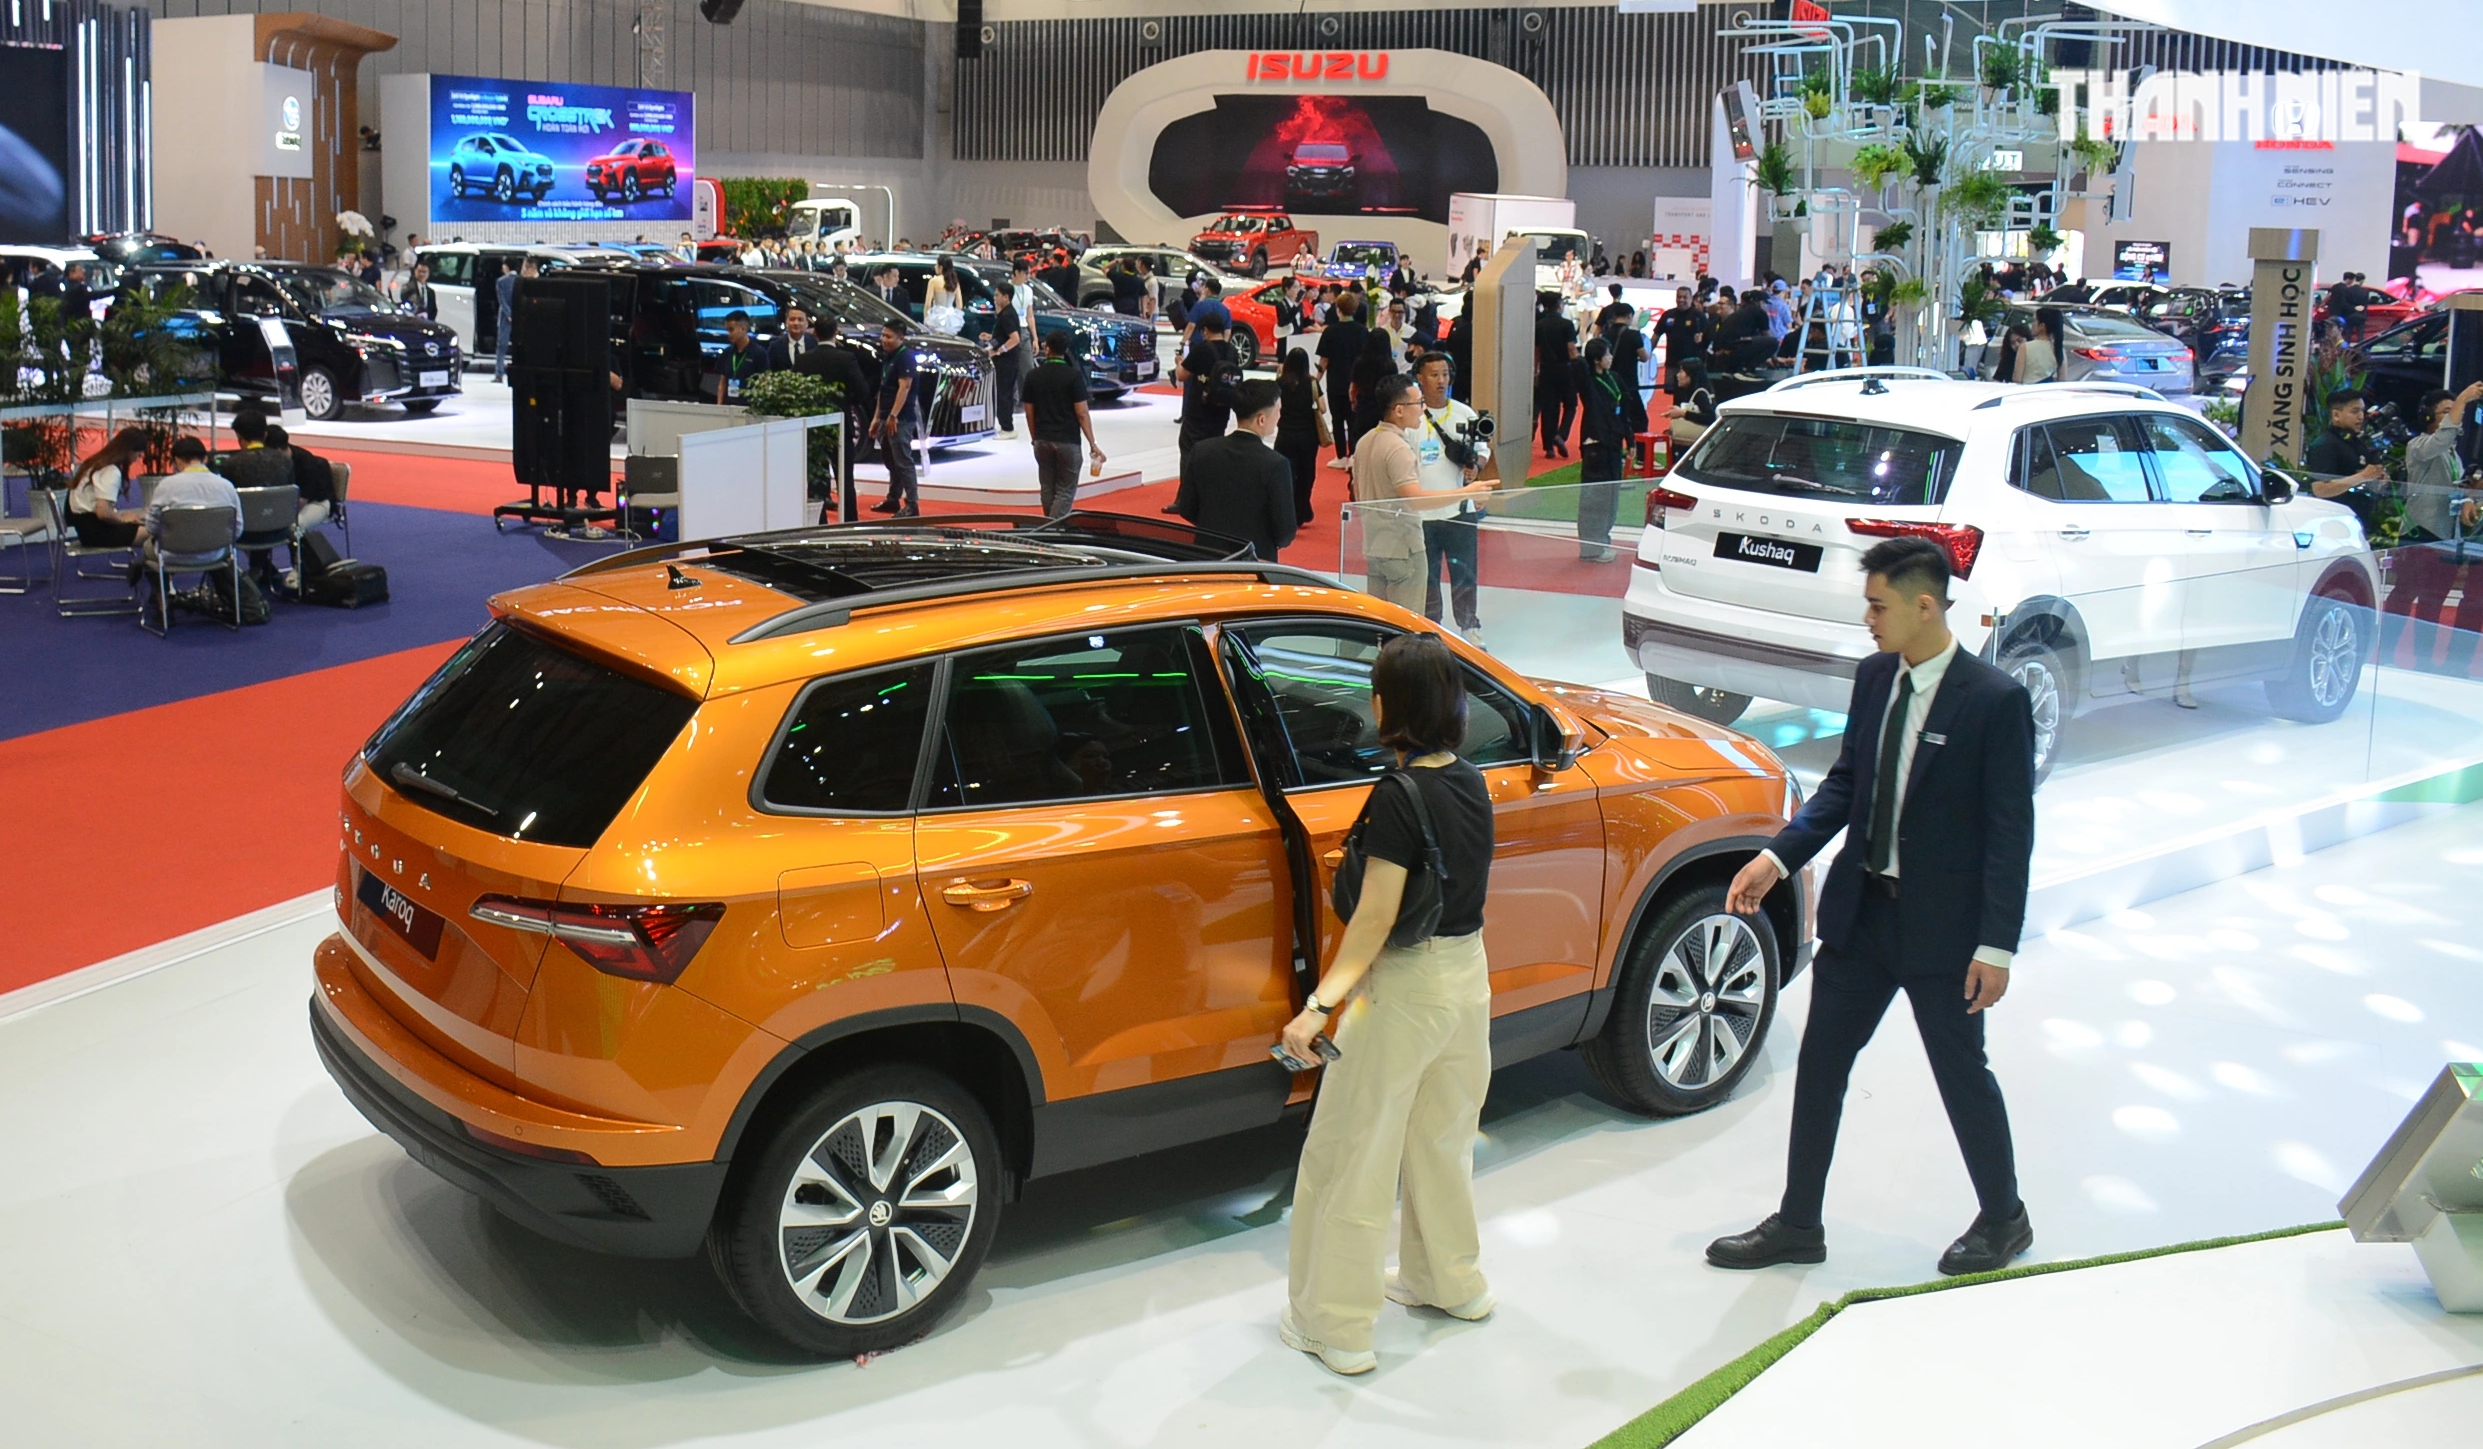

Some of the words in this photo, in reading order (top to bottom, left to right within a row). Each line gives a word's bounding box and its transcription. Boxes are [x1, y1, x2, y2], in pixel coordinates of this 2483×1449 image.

[1246, 52, 1389, 80] ISUZU
[527, 94, 564, 106] SUBARU
[2254, 139, 2335, 151] HONDA
[2280, 268, 2305, 318] HỌC
[2276, 324, 2297, 377] SINH
[2267, 383, 2293, 447] XĂNG
[1738, 535, 1795, 566] Kushaq
[380, 883, 415, 934] Karoq
